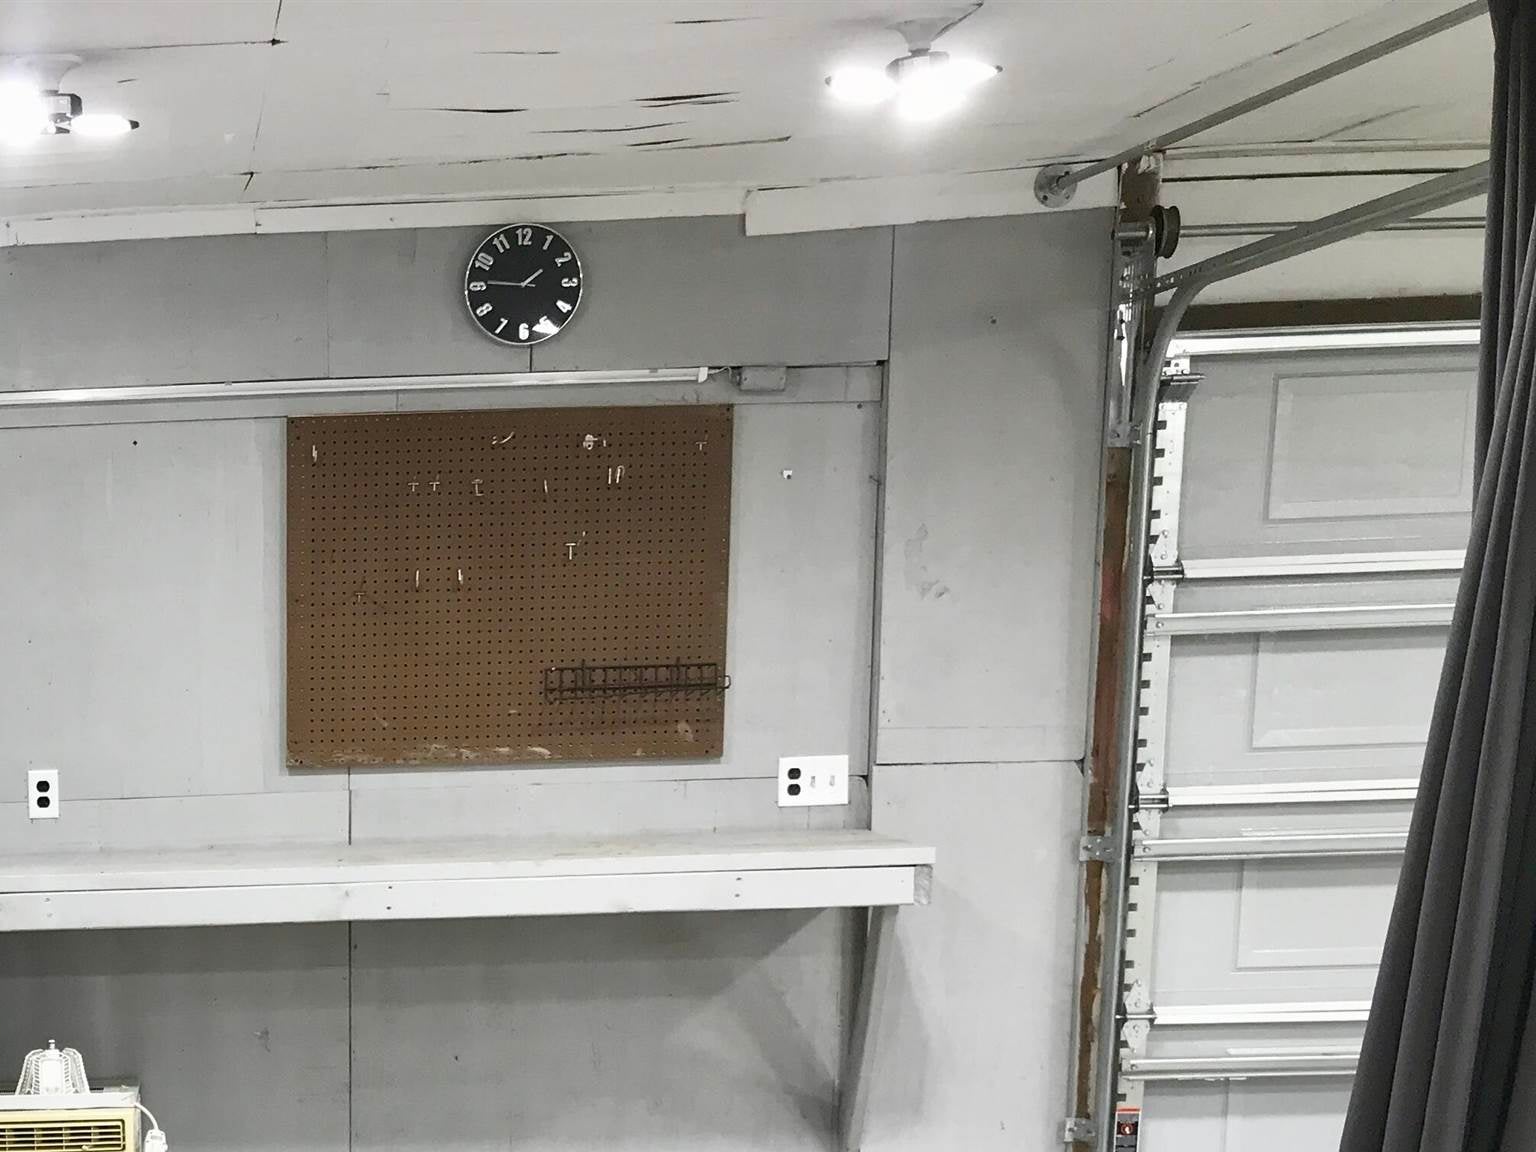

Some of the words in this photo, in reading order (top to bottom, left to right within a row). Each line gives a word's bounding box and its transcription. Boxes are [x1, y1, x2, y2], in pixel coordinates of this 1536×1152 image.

[492, 234, 510, 253] 11
[515, 228, 533, 245] 12
[542, 234, 554, 250] 1
[475, 252, 494, 271] 10
[555, 252, 572, 267] 2
[469, 281, 487, 291] 9
[561, 277, 578, 288] 3
[475, 302, 493, 317] 8
[556, 300, 573, 313] 4
[494, 318, 508, 334] 7
[518, 323, 530, 340] 6
